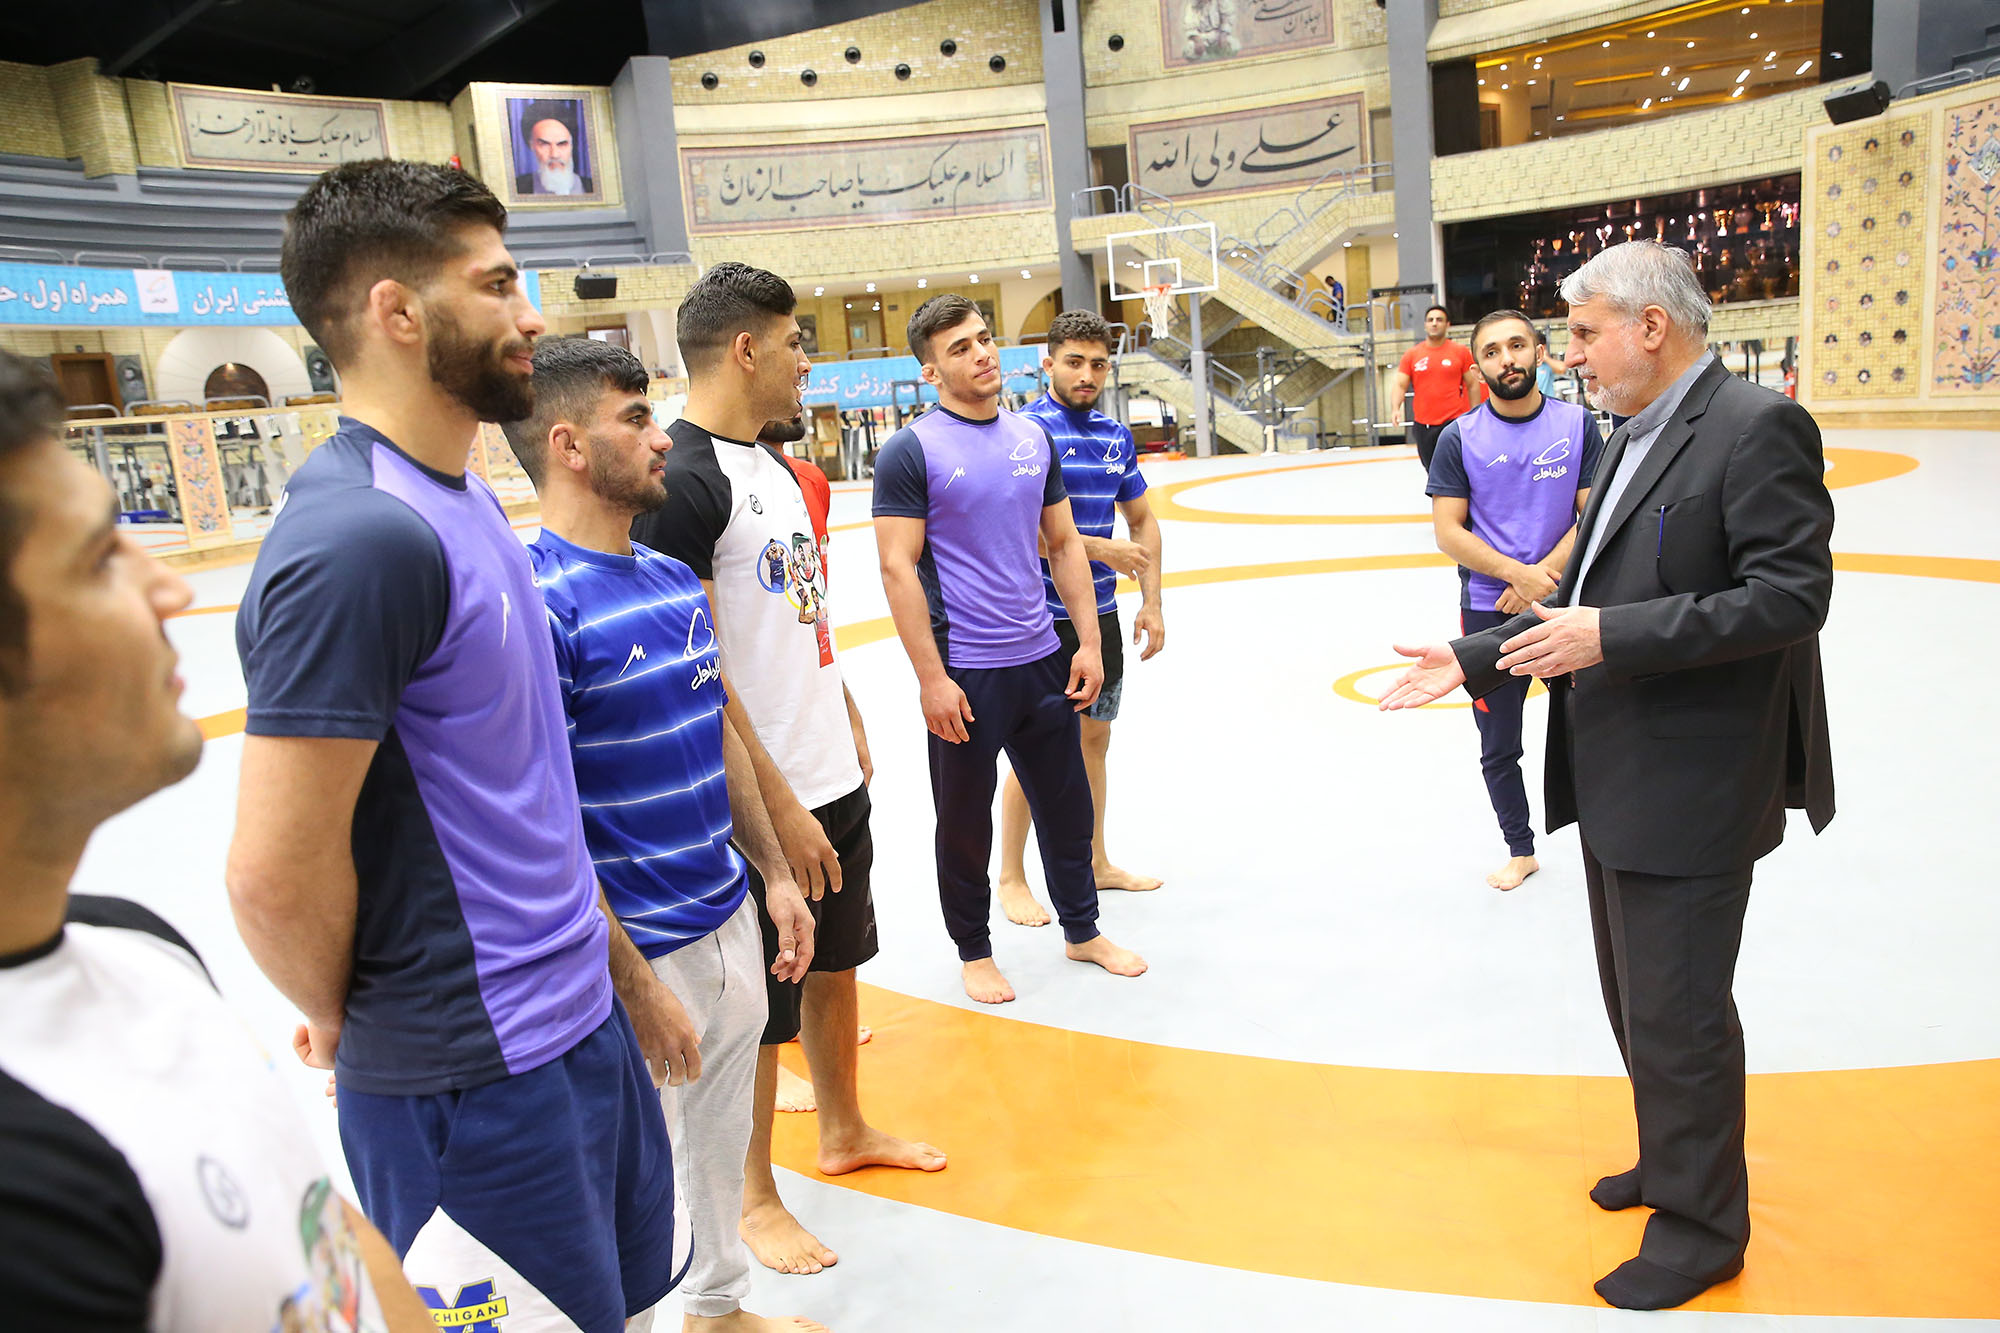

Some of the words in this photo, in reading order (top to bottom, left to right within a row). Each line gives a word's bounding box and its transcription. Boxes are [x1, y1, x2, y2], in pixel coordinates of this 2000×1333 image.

[953, 148, 1014, 215] السلام
[71, 280, 128, 313] همراه
[192, 285, 240, 316] ایران
[243, 287, 291, 315] شتی
[433, 1304, 499, 1323] CHIGAN
